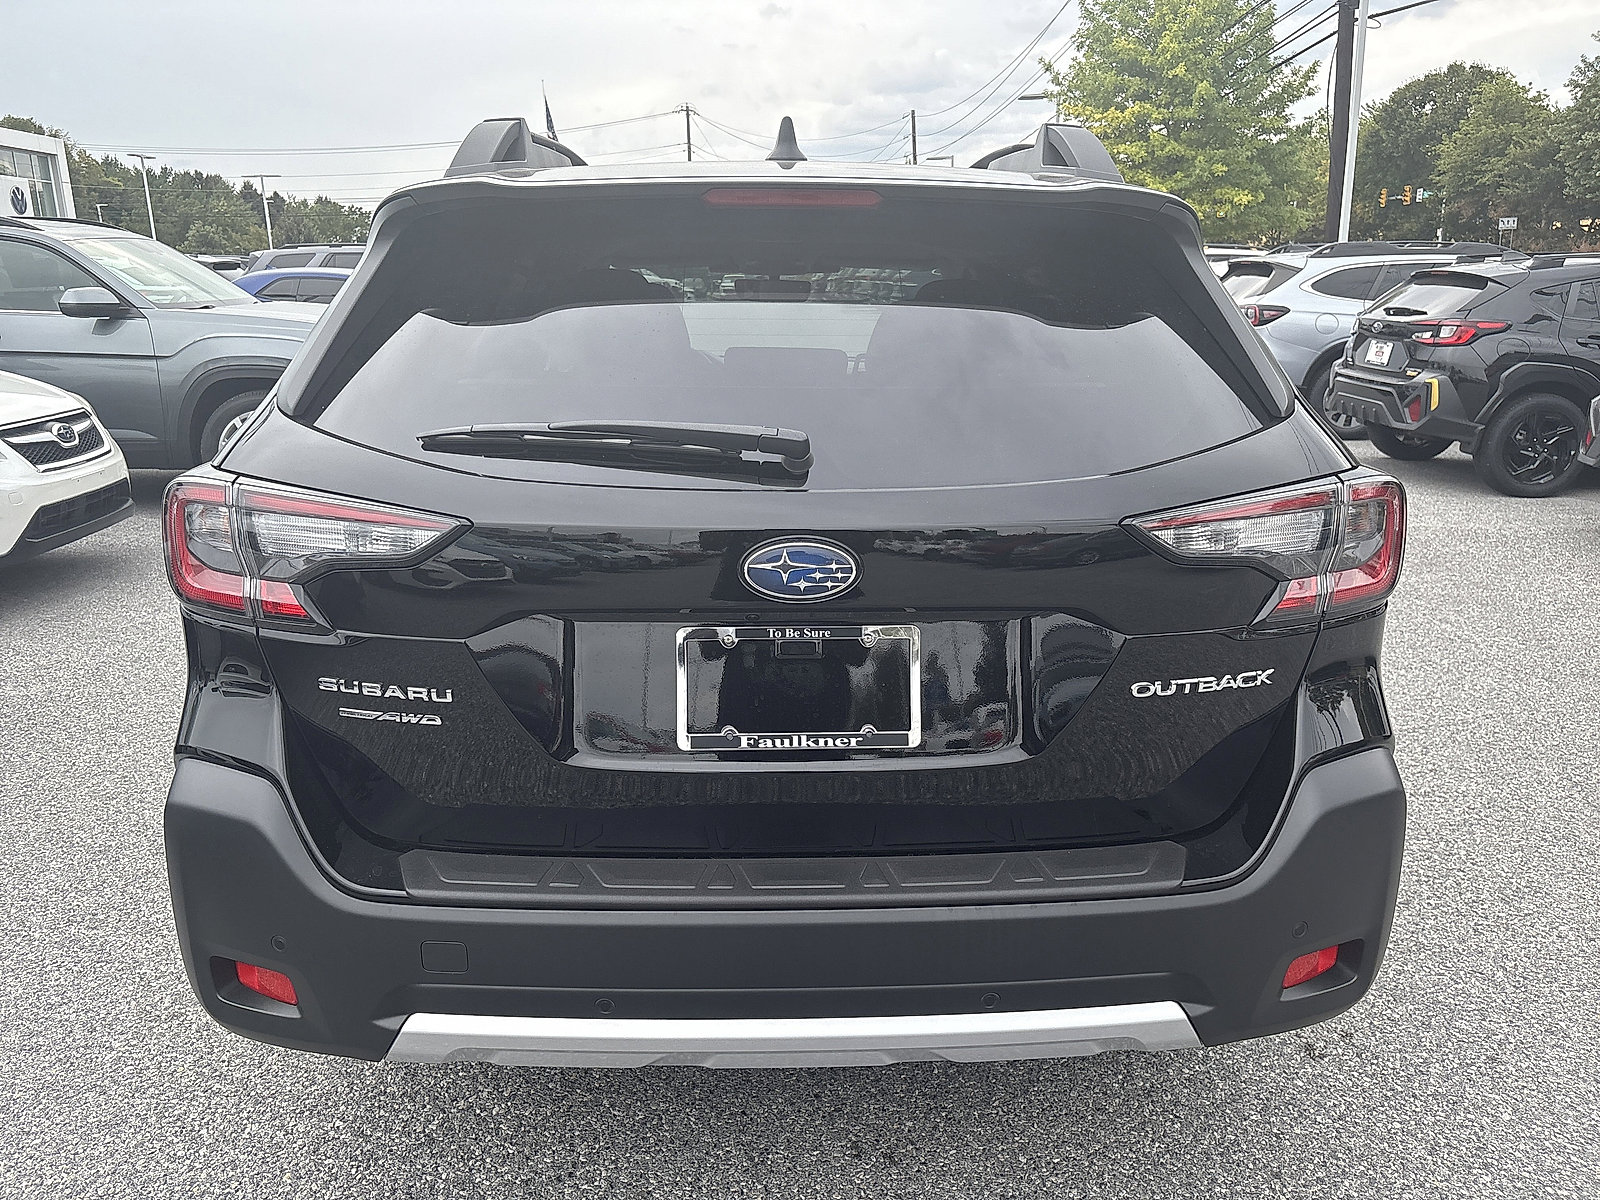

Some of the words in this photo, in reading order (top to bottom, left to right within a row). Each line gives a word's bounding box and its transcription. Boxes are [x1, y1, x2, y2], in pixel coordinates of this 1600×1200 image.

[767, 628, 782, 638] To
[785, 628, 801, 638] Be
[803, 628, 831, 638] Sure
[317, 677, 453, 703] SUBARU
[1130, 668, 1275, 698] OUTBACK
[376, 711, 442, 726] AWD
[739, 735, 863, 749] Faulkner
